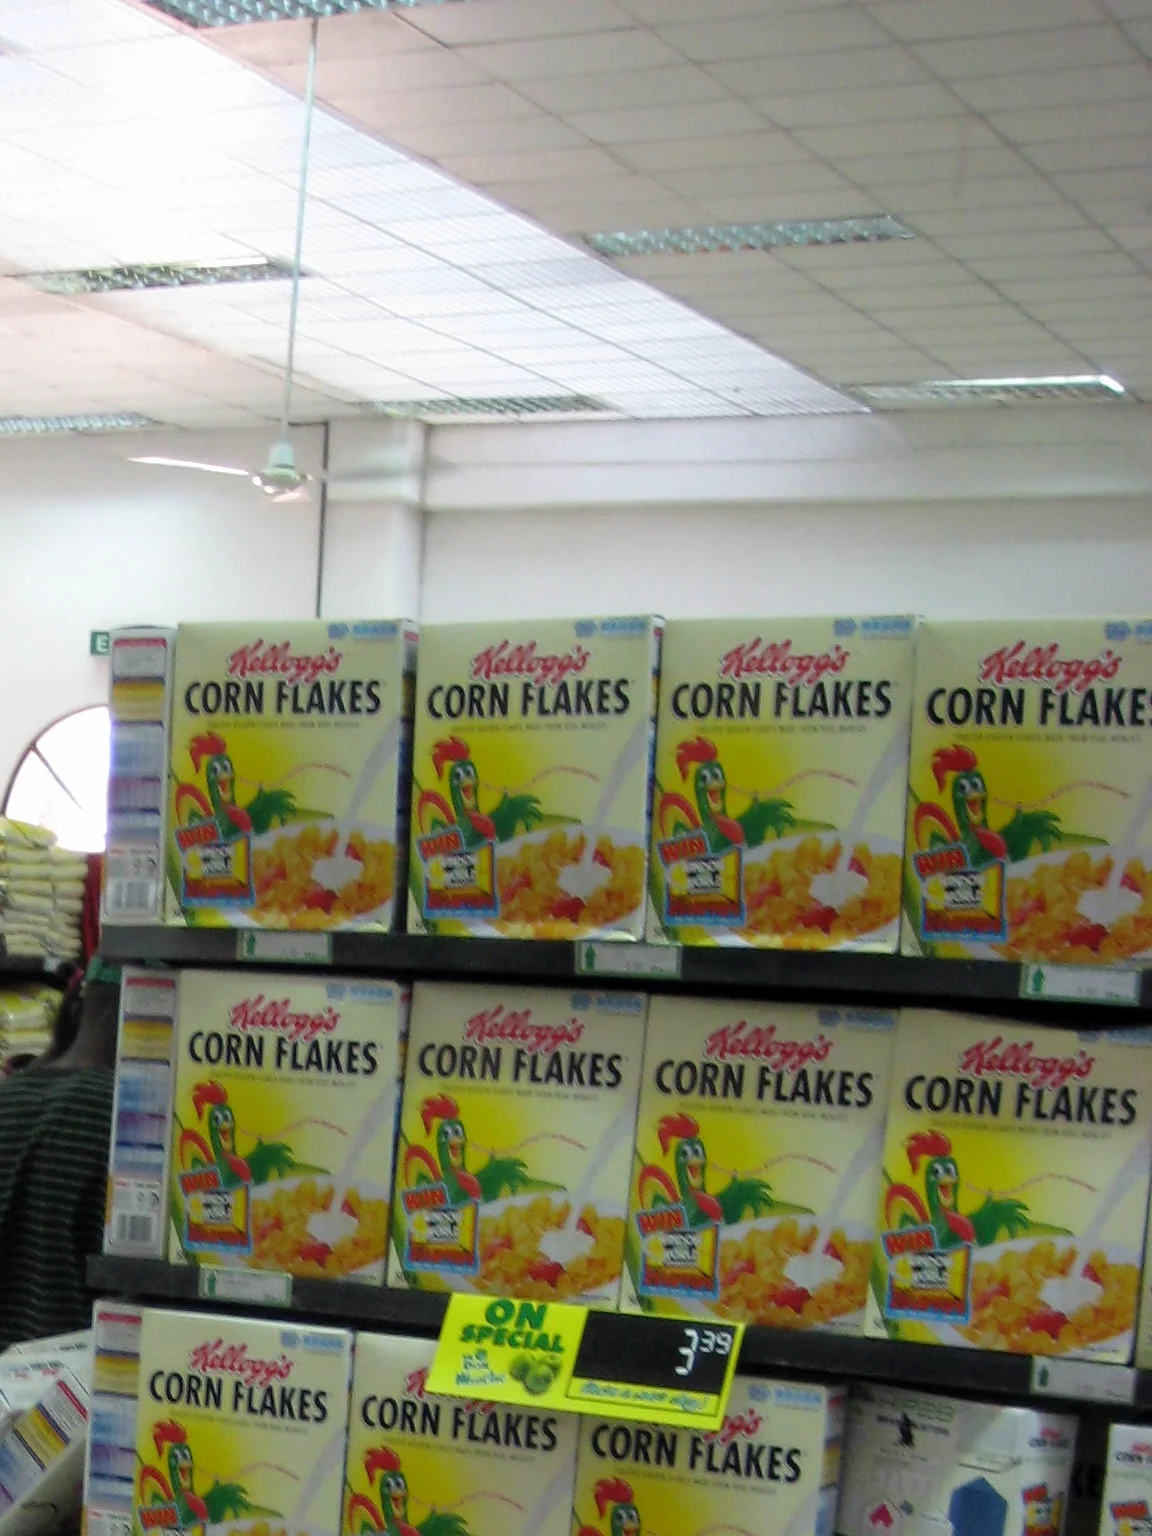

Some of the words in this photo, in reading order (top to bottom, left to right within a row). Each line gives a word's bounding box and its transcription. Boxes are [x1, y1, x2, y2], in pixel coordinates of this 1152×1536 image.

[227, 638, 342, 686] Kellogg's
[471, 639, 591, 685] Kellogg's
[719, 636, 850, 686] Kellogg's
[979, 640, 1123, 694] Kellogg's
[184, 680, 264, 714] CORN
[276, 680, 382, 714] FLAKES
[426, 683, 509, 718] CORN
[521, 679, 630, 717] FLAKES
[670, 681, 761, 719] CORN
[774, 680, 892, 718] FLAKES
[926, 687, 1025, 727] CORN
[1039, 687, 1152, 727] FLAKE
[915, 848, 965, 874] WIN
[228, 994, 341, 1042] Kellogg's
[463, 1004, 586, 1055] Kellogg's
[187, 1031, 264, 1070] CORN
[275, 1034, 378, 1076] FLAKES
[417, 1043, 503, 1080] CORN
[512, 1048, 624, 1089] FLAKES
[705, 1020, 834, 1073] Kellogg's
[959, 1036, 1096, 1089] Kellogg's
[655, 1060, 745, 1098] CORN
[755, 1066, 874, 1108] FLAKES
[904, 1074, 1002, 1118] CORN
[1015, 1081, 1138, 1127] FLAKES
[640, 1210, 685, 1234] WIN
[886, 1230, 935, 1255] WIN
[459, 1323, 565, 1353] SPECIAL
[484, 1299, 548, 1330] ON
[190, 1338, 295, 1389] Kellogg's
[149, 1370, 222, 1413] CORN
[232, 1381, 329, 1424] FLAKES
[361, 1395, 440, 1436] CORN
[452, 1406, 558, 1452] FLAKES
[591, 1424, 677, 1468] CORN
[689, 1437, 802, 1484] FLAKES
